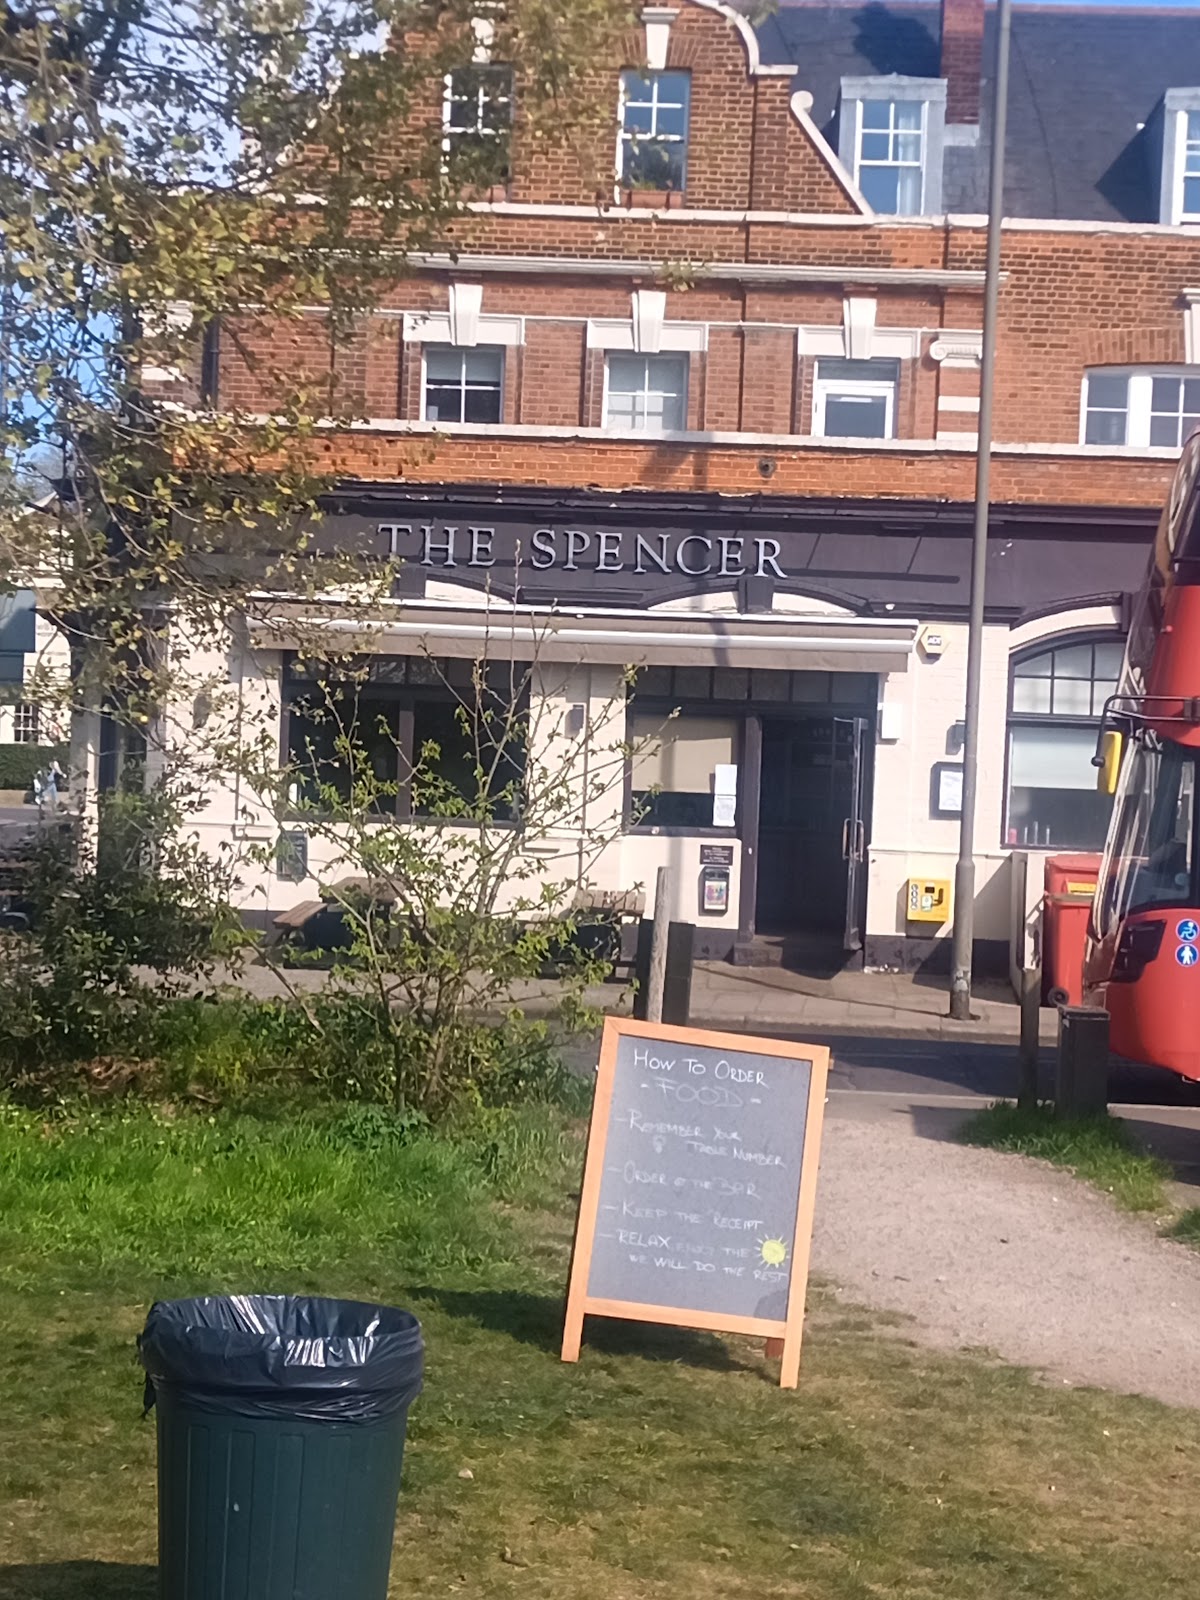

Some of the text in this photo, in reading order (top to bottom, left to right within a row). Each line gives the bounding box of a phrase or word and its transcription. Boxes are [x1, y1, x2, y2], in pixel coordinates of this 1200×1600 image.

[377, 523, 788, 579] THE SPENCER
[653, 1077, 743, 1106] FOOD
[616, 1229, 671, 1249] RELAX
